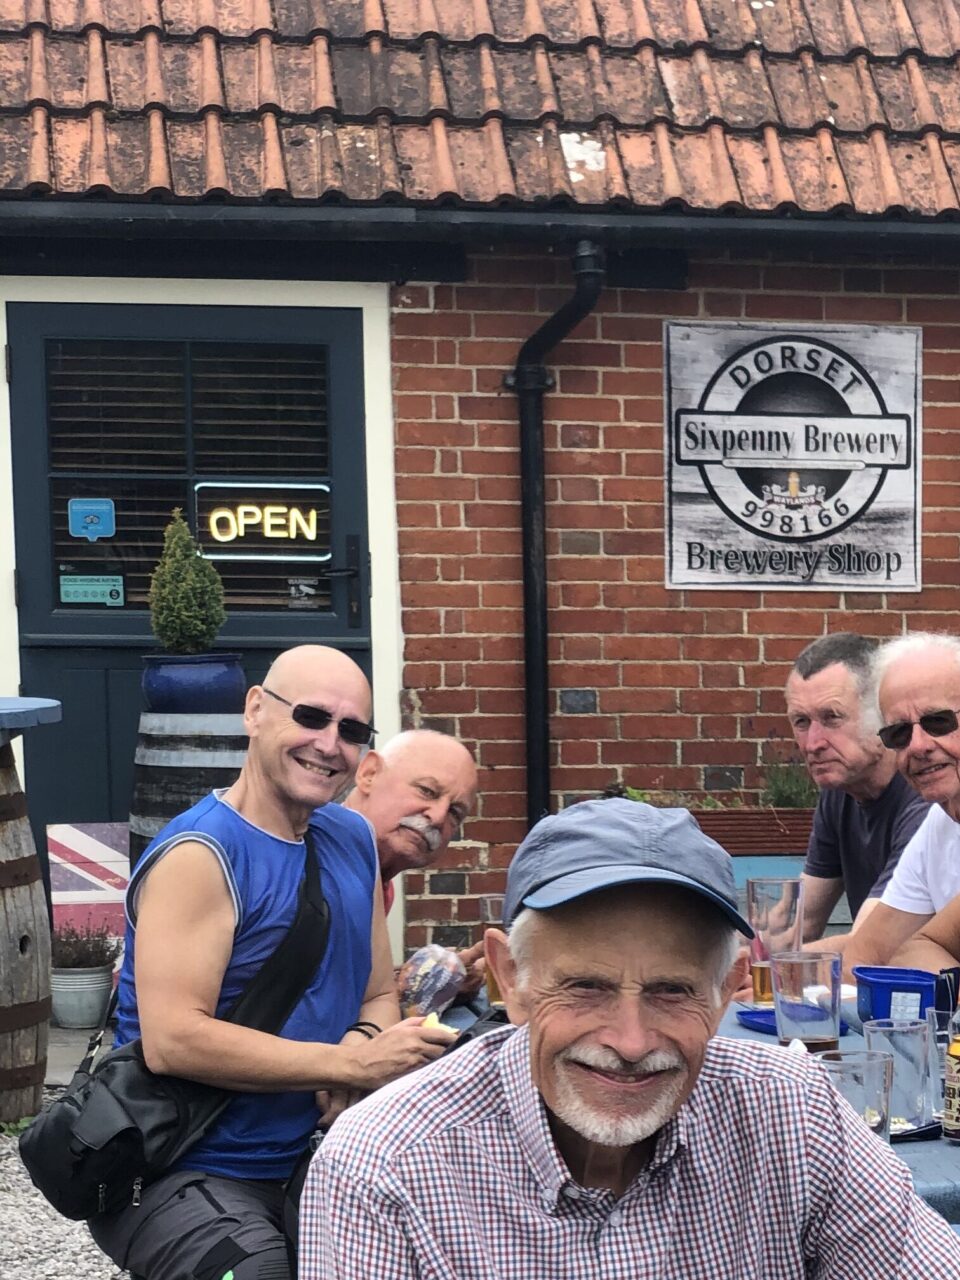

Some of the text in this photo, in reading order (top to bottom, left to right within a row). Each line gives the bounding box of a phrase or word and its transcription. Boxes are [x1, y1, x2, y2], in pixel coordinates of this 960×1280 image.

[728, 345, 863, 394] DORSET
[683, 420, 903, 461] Sixpenny Brewery
[208, 504, 318, 543] OPEN
[740, 498, 850, 534] 998166
[685, 540, 903, 582] Brewery Shop
